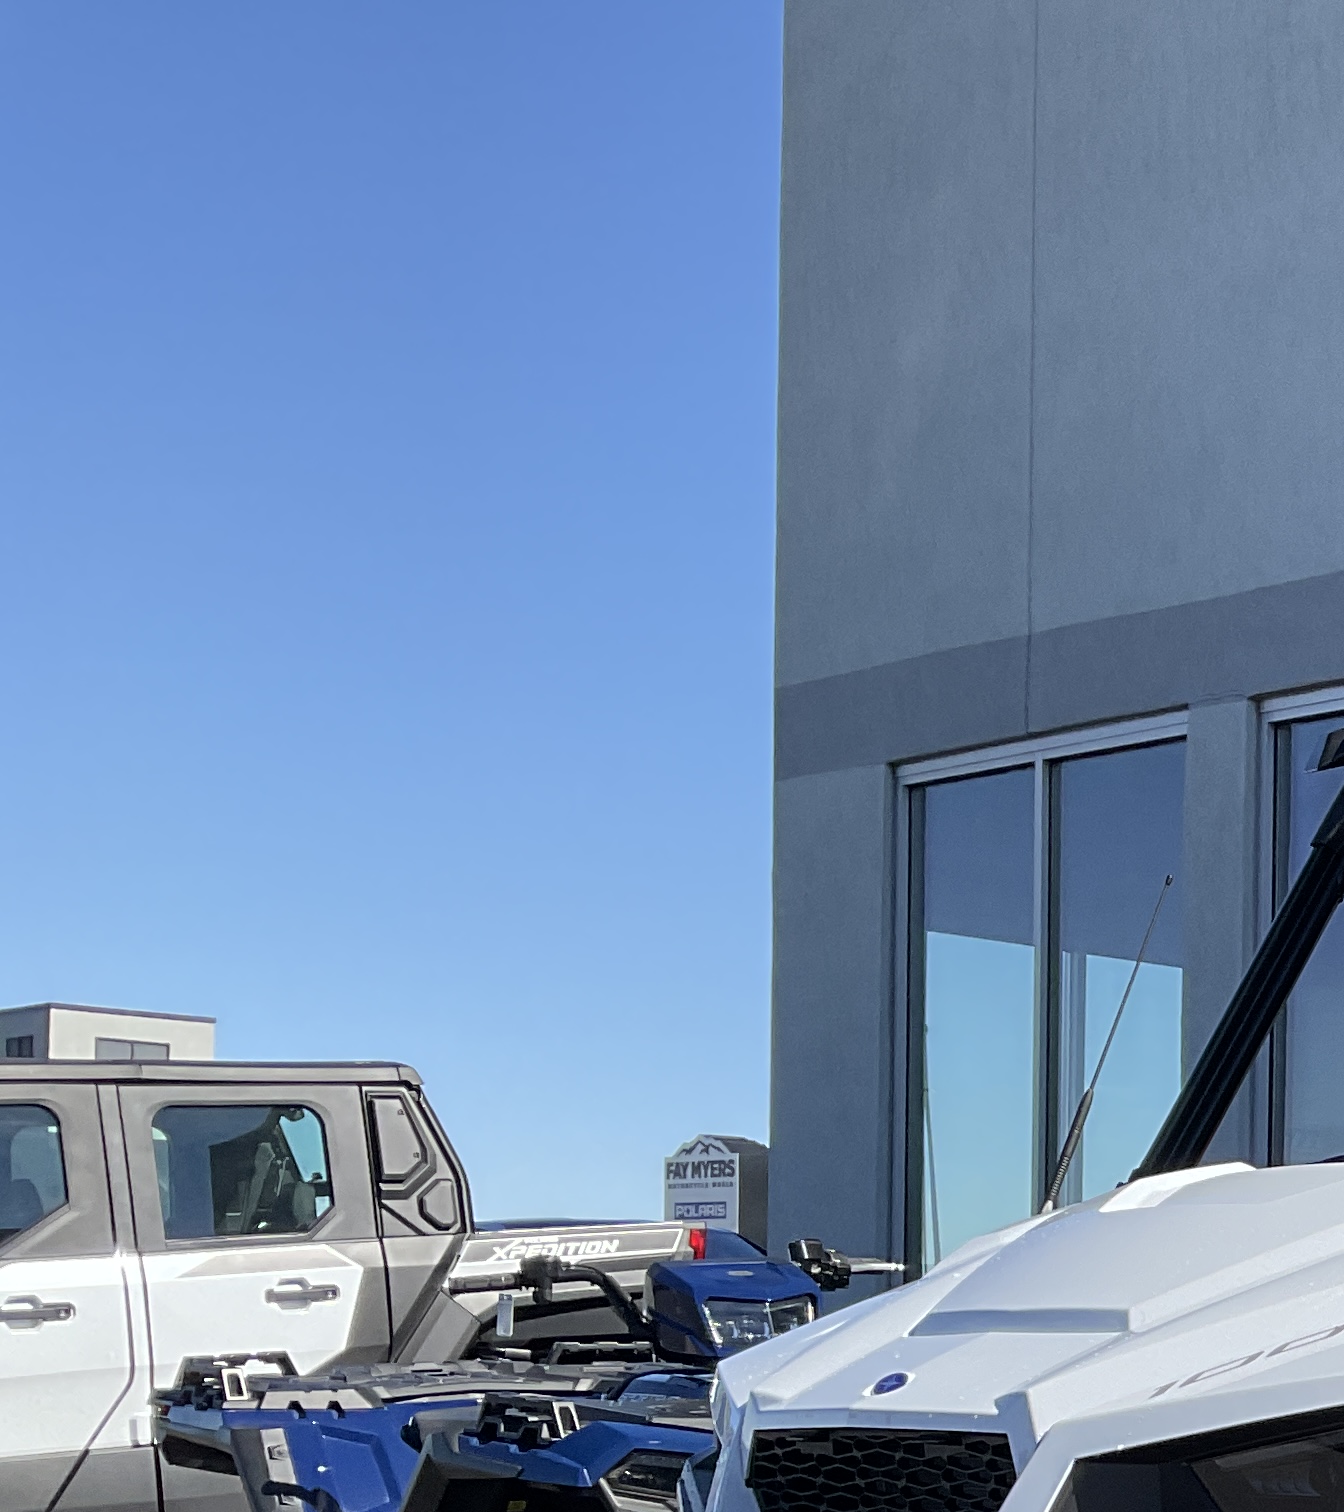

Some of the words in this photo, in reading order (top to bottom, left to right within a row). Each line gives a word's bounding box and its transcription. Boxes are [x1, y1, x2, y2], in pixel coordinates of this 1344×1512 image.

[666, 1161, 689, 1180] FAY
[691, 1159, 735, 1179] MYERS
[675, 1202, 726, 1218] POLARIS
[485, 1238, 620, 1262] XPEDITION
